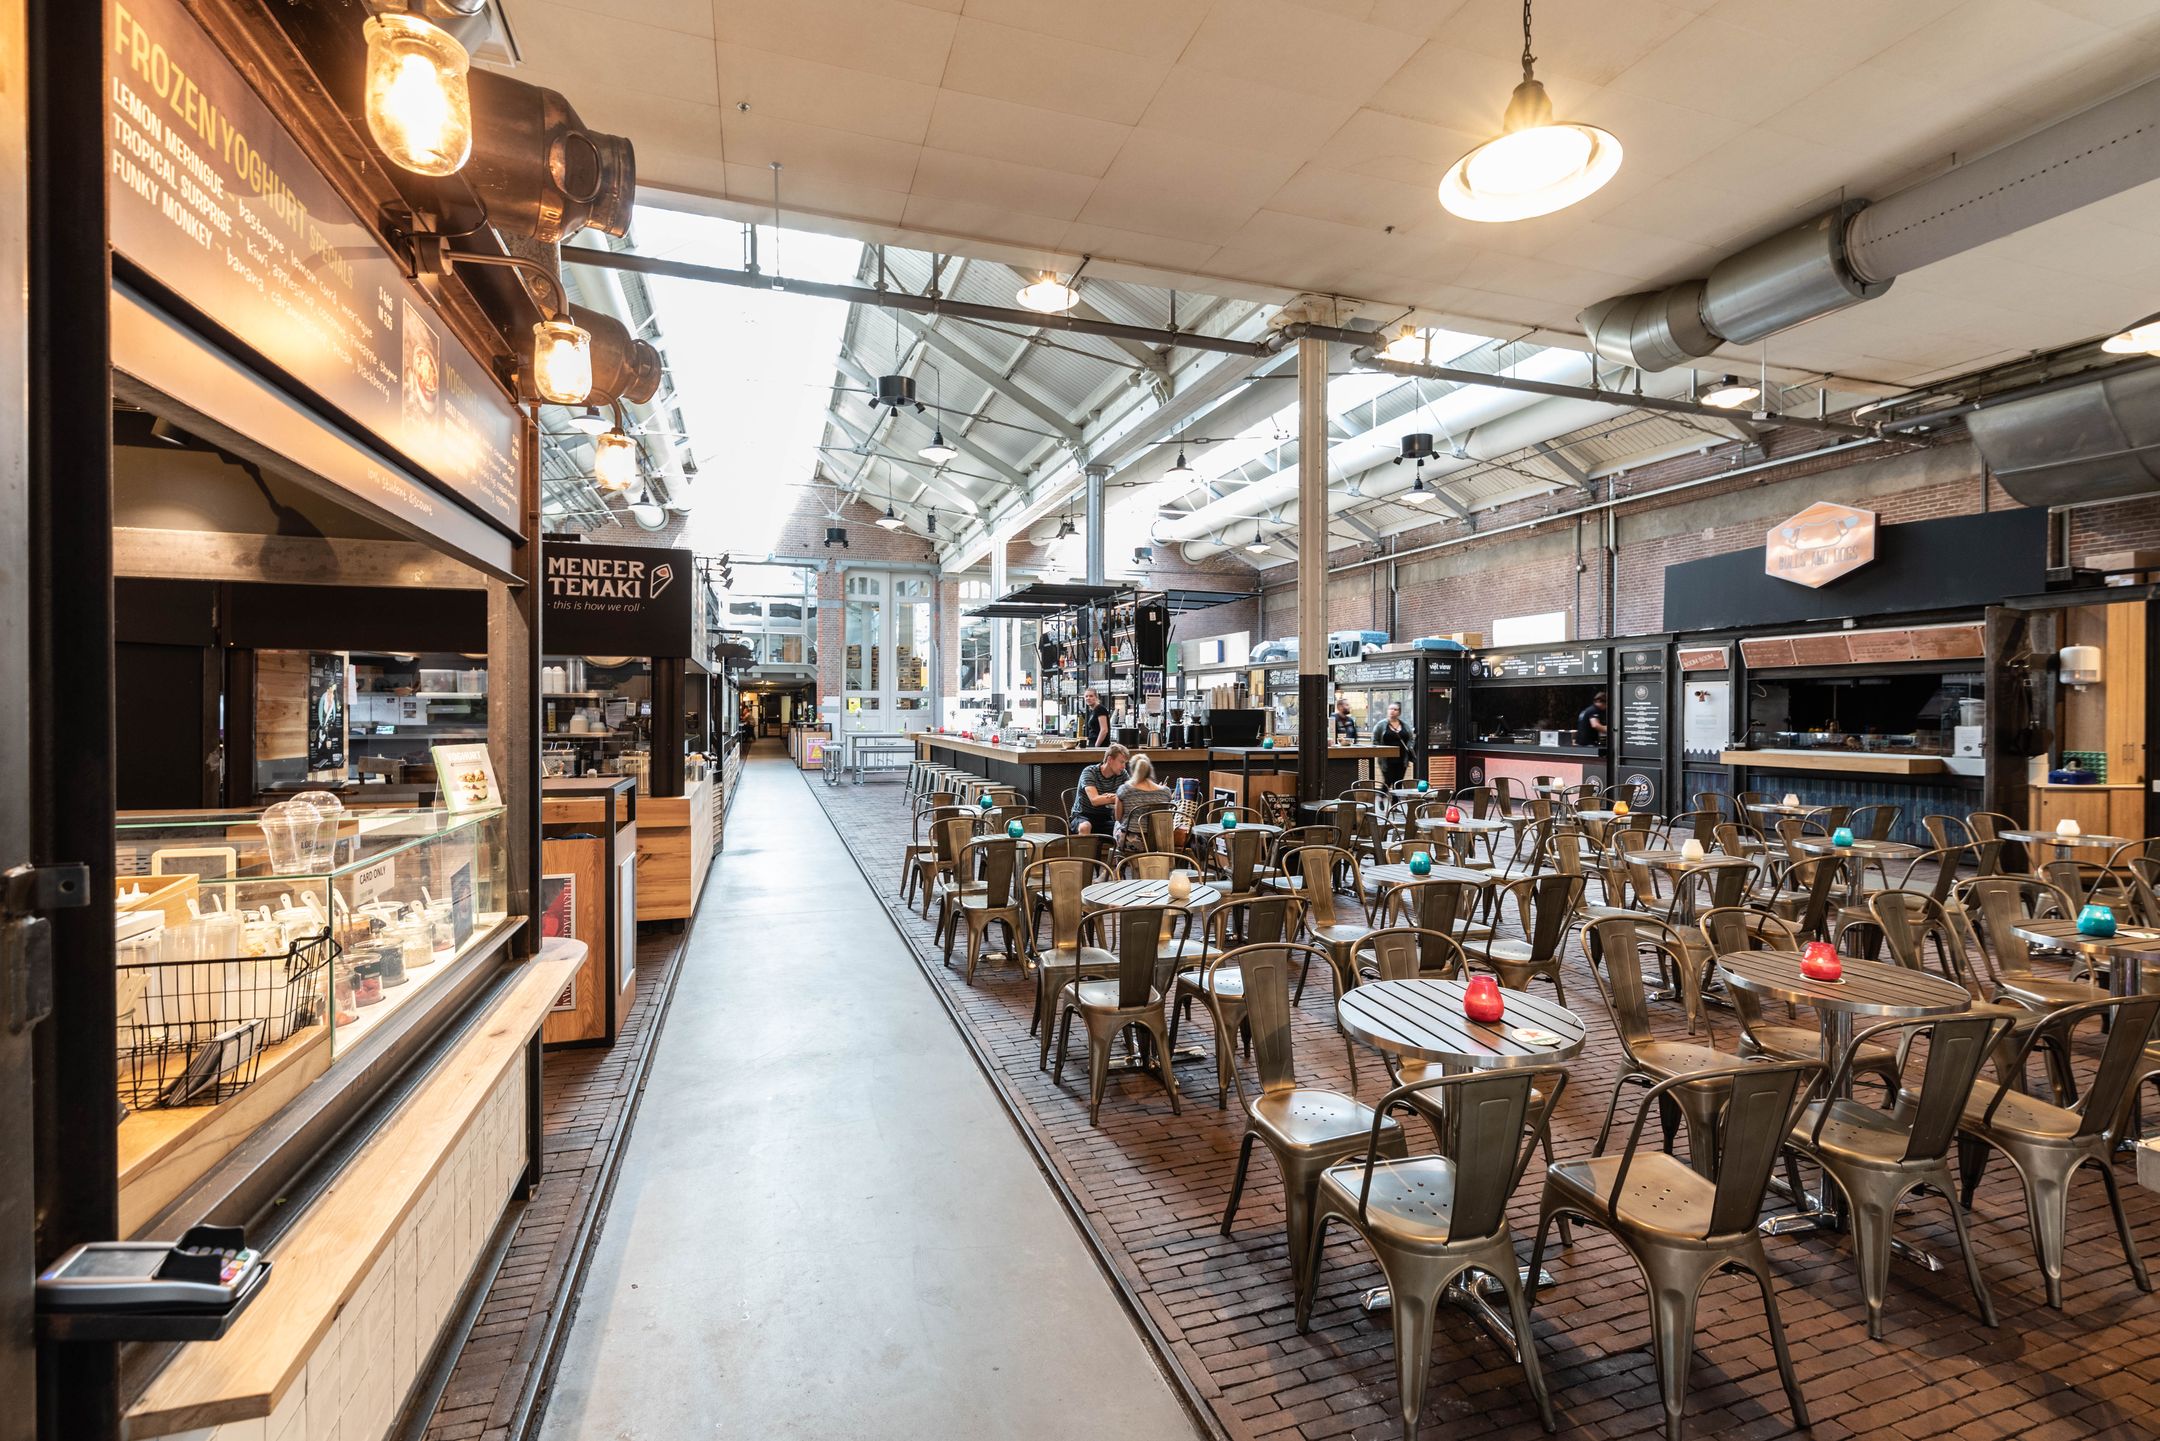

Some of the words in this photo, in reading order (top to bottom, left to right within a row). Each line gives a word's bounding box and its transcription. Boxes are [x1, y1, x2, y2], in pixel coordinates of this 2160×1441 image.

[115, 2, 217, 150] FROZEN
[221, 116, 308, 239] YOGHURT
[309, 224, 354, 289] SPECIALS
[112, 112, 178, 190] TROPICAL
[180, 175, 232, 237] SURPRISE
[113, 76, 162, 142] LEMON
[165, 126, 224, 200] MERINGUE
[290, 249, 317, 285] lemon
[112, 149, 159, 206] FUNKY
[162, 192, 213, 250] MONKEY
[382, 475, 408, 502] student
[409, 490, 433, 517] discount
[548, 557, 645, 579] MENEER
[548, 577, 641, 598] TEMAKI
[553, 600, 571, 610] this
[574, 600, 582, 610] is
[584, 601, 605, 611] how
[607, 604, 622, 612] we
[623, 602, 640, 612] roll
[446, 750, 482, 763] YOGHURT
[359, 871, 373, 886] CARD
[373, 866, 387, 880] ONLY
